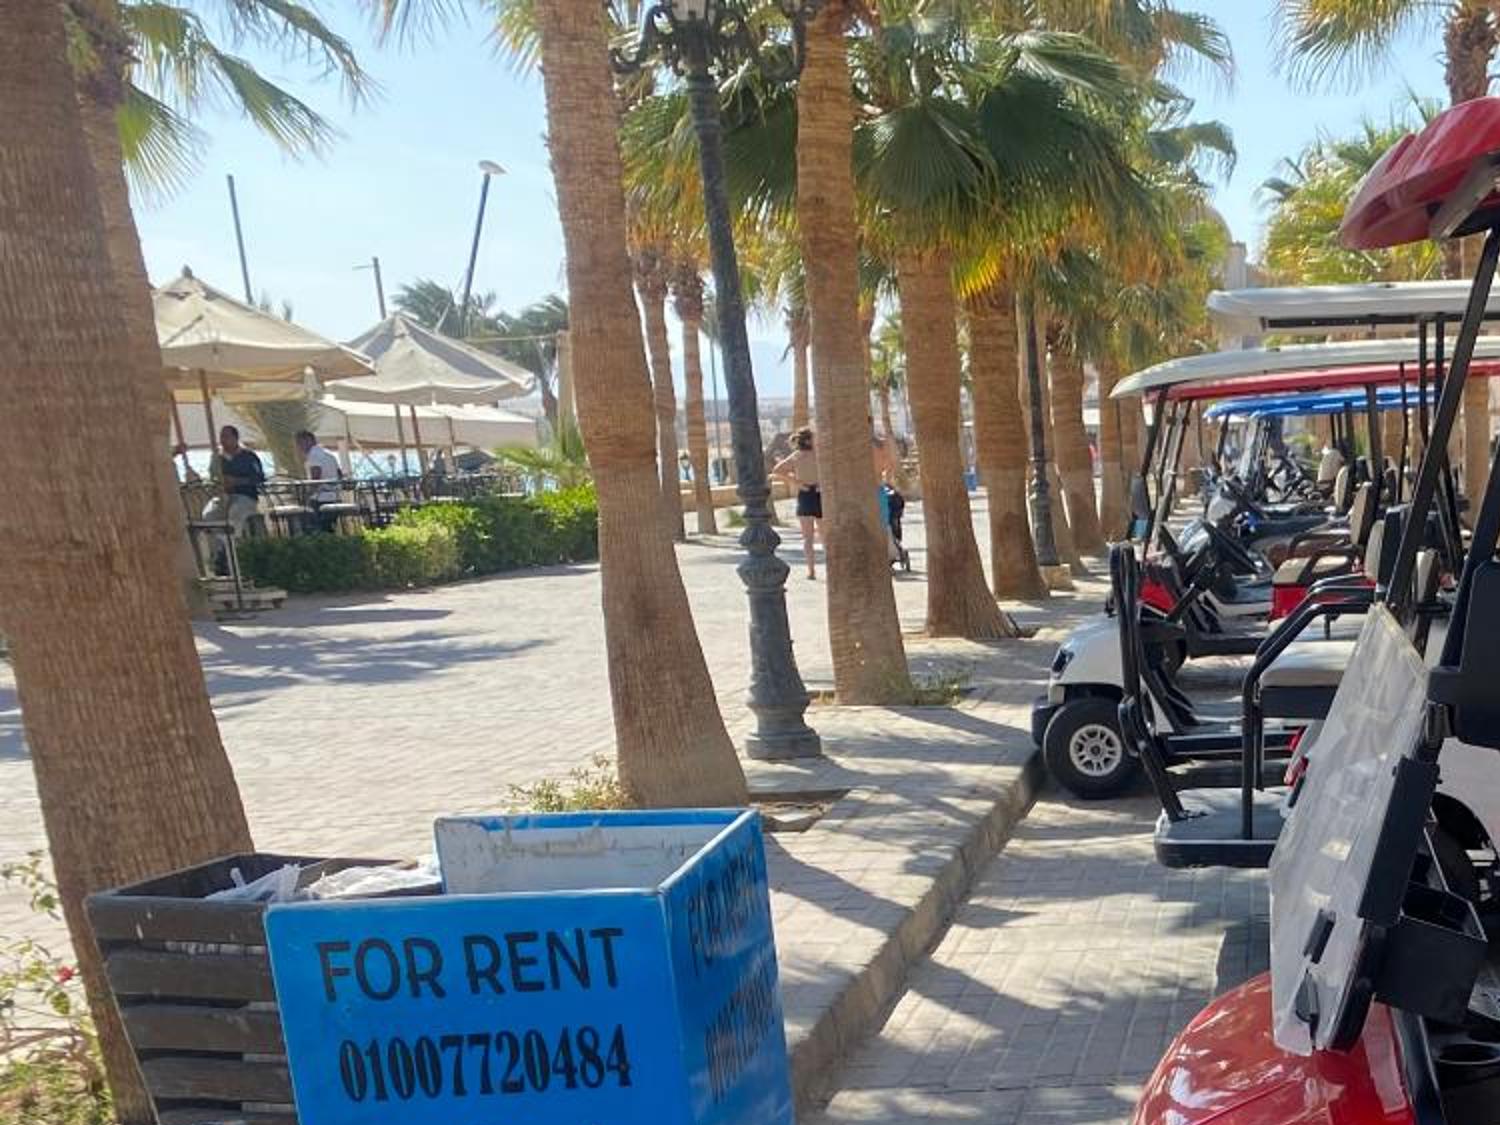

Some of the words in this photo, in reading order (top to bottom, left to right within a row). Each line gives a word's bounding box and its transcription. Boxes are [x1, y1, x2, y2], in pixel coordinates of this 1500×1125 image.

[316, 937, 447, 1001] FOR
[463, 928, 624, 994] RENT
[339, 1023, 632, 1103] 01007720484
